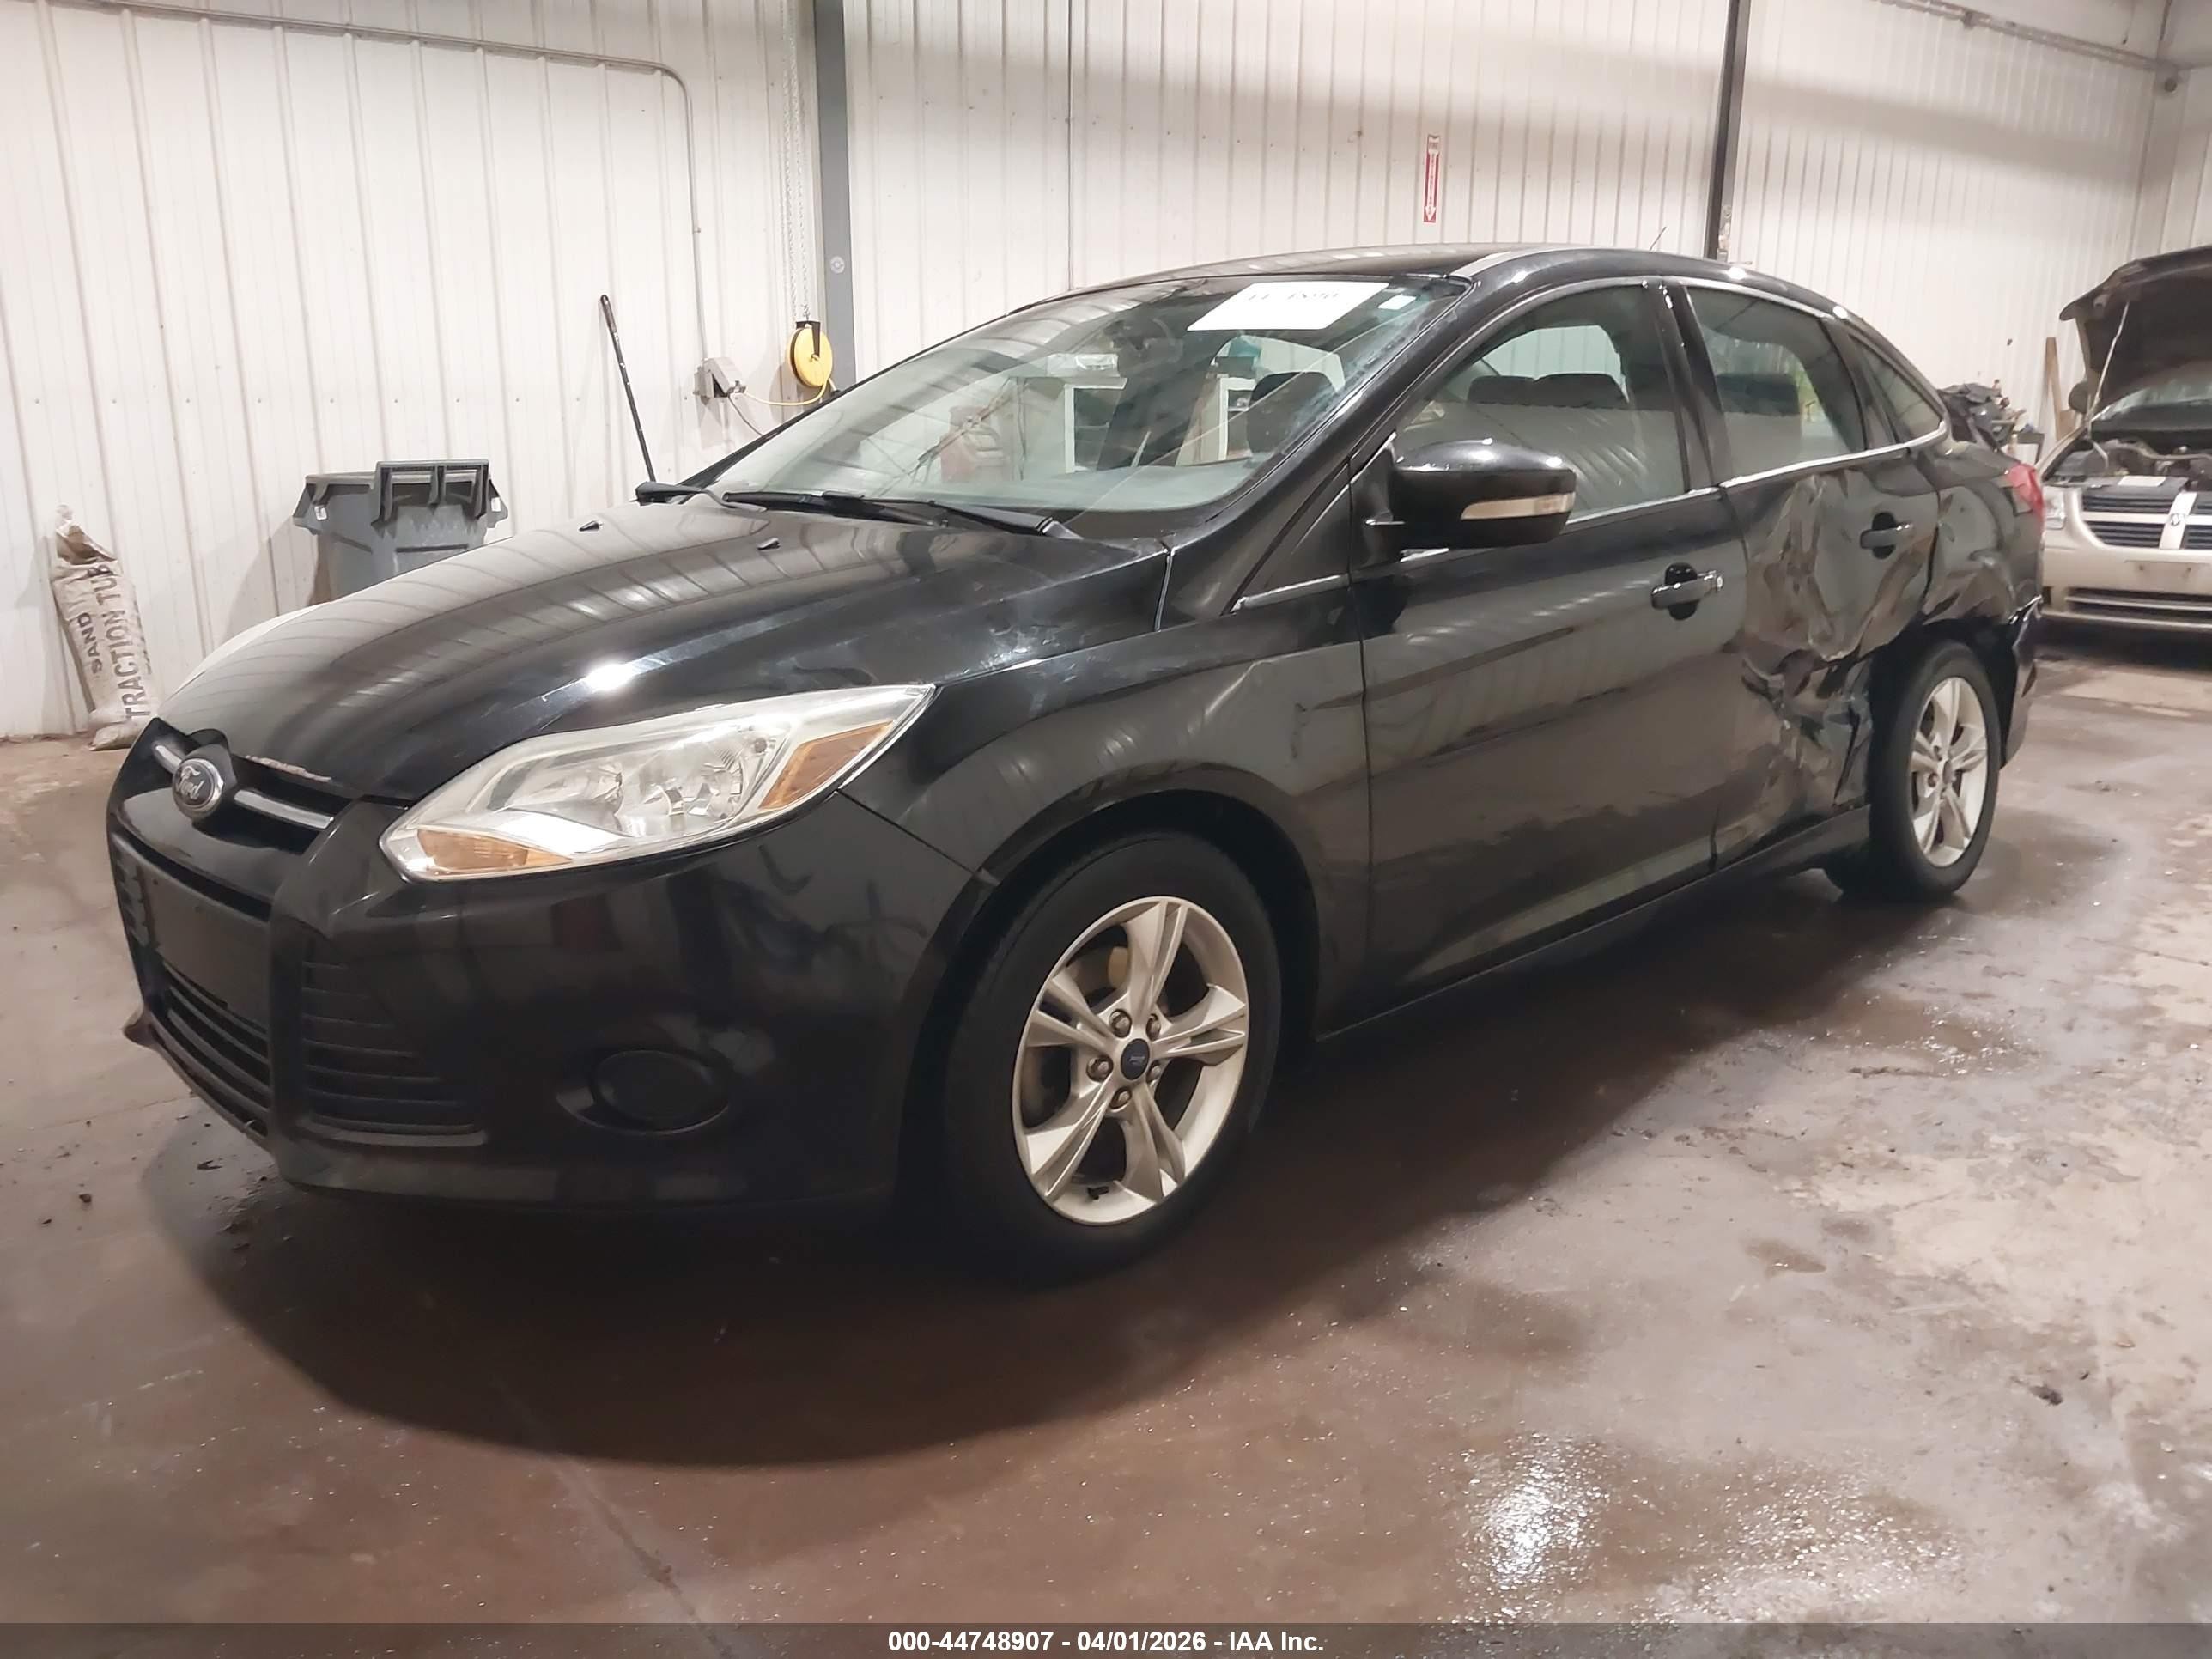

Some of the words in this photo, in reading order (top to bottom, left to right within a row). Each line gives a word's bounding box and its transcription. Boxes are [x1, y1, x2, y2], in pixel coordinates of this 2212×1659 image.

[76, 611, 103, 674] SAND
[102, 608, 151, 721] TRACTION
[175, 765, 205, 800] Ford
